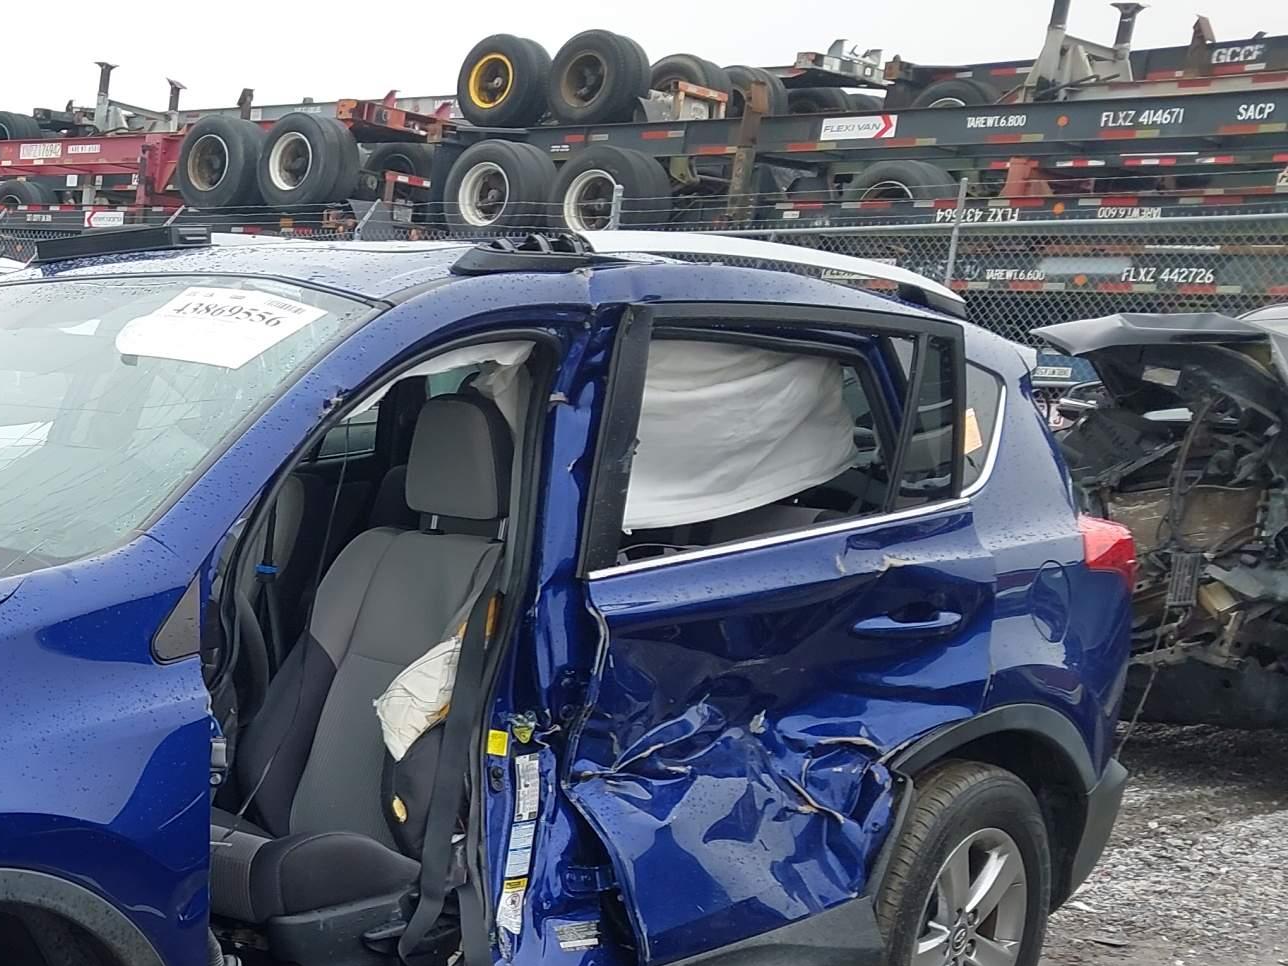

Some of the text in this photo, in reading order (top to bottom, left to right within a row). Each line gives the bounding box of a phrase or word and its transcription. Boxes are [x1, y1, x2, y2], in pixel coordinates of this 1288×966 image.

[1100, 107, 1184, 127] FLXZ 414671
[1237, 102, 1275, 121] SACP
[823, 123, 881, 133] FLEXI VAN
[987, 207, 1020, 222] FLXZ
[1121, 267, 1215, 284] FLXZ 442726
[173, 302, 288, 327] 43869556
